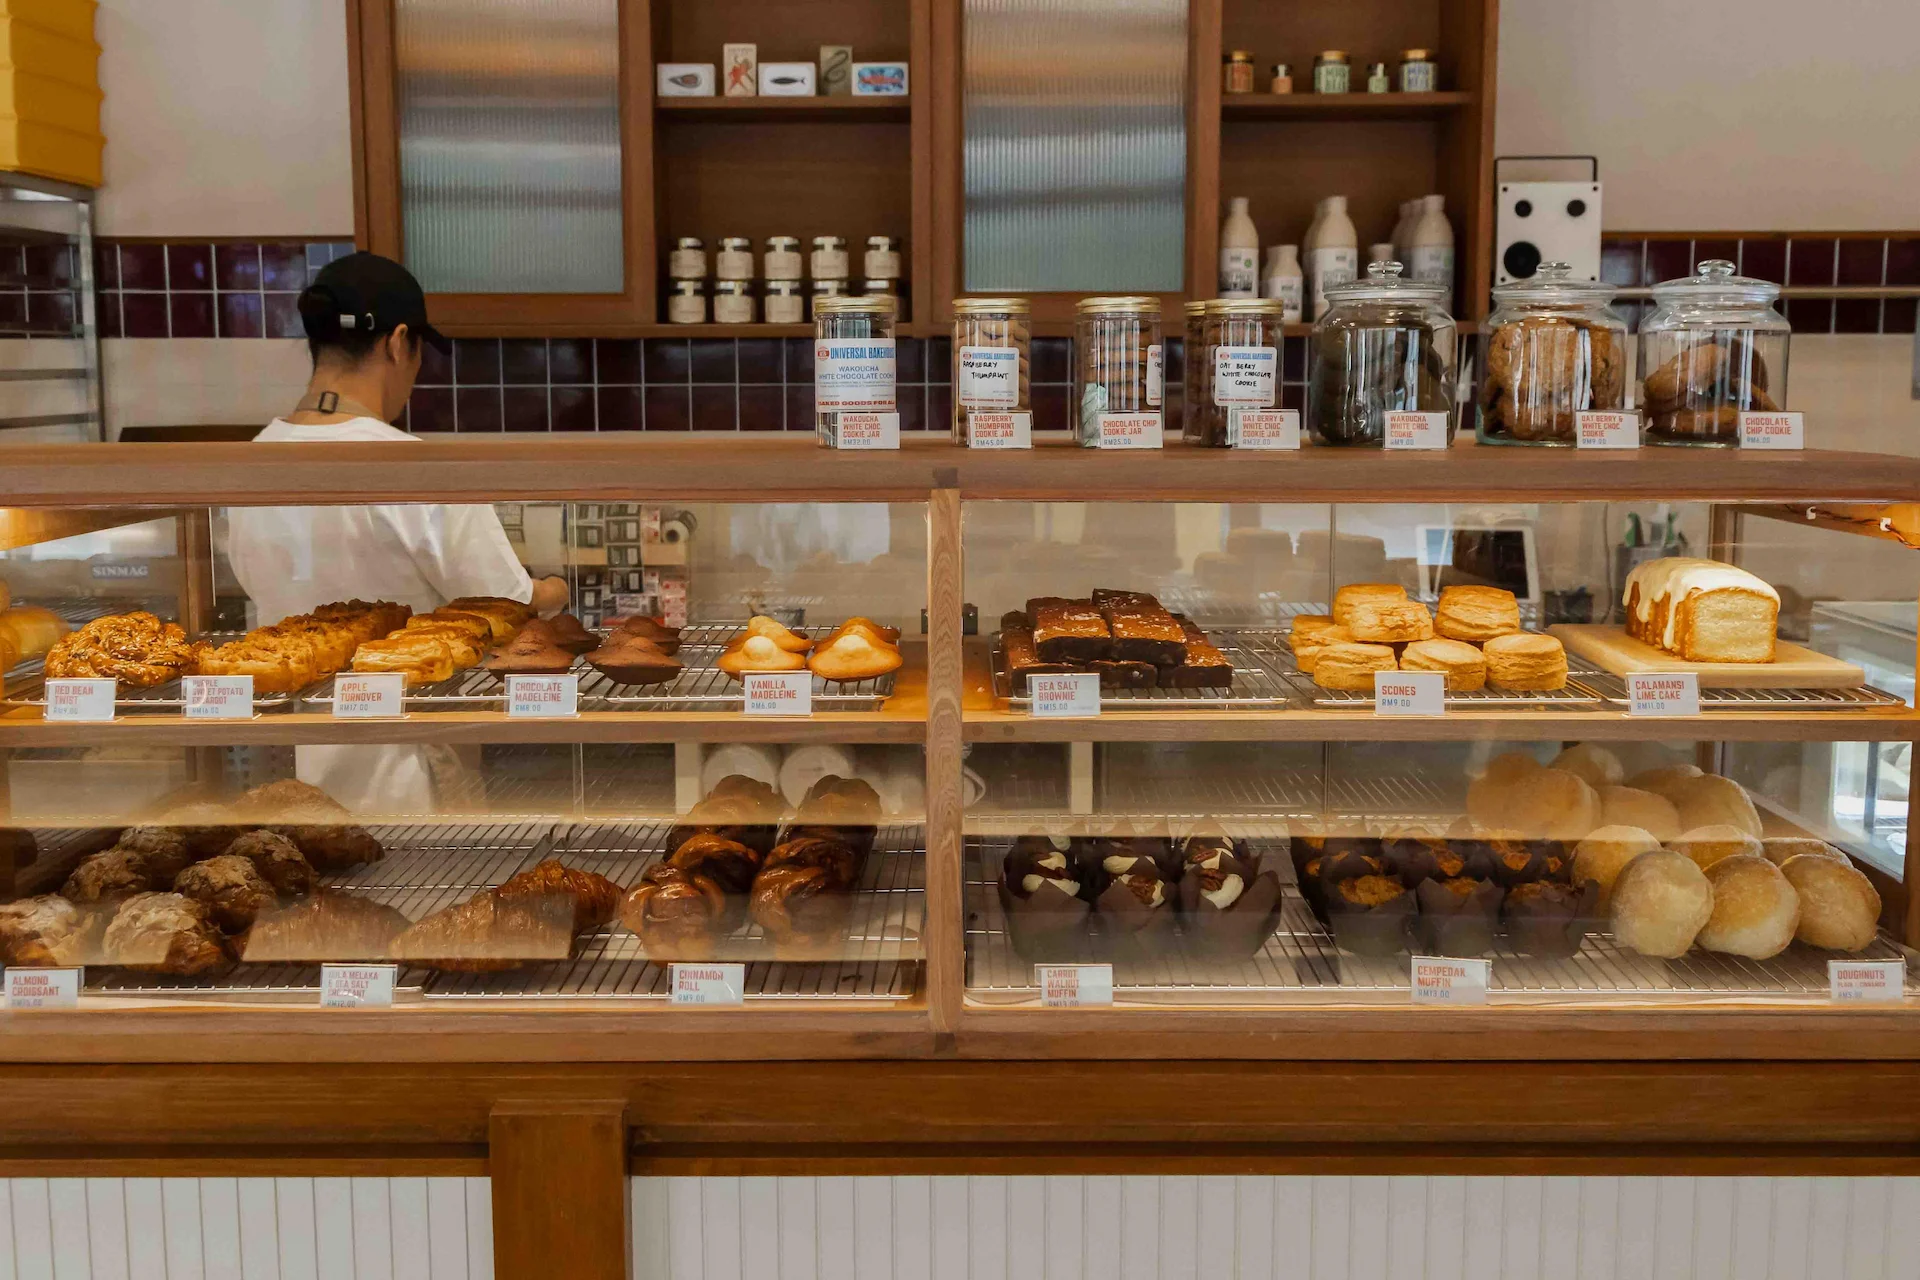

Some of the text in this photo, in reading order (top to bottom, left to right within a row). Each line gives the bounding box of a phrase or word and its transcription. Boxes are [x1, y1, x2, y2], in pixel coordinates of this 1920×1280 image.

[830, 347, 868, 360] UNIVERSAL
[838, 365, 880, 373] WAKOUCHA
[843, 415, 879, 423] WAKOUCHA
[1103, 419, 1157, 428] CHOCOLATE CHIP
[1390, 415, 1427, 423] WAKOUCHA
[1745, 417, 1790, 426] CHOCOLATE
[843, 430, 880, 438] COOKIE JAR
[975, 430, 1014, 438] COOKIE JAR
[1103, 427, 1142, 436] COOKIE JAR
[1390, 430, 1413, 438] COOKIE
[1746, 426, 1792, 435] CHIP COOKIE
[1103, 438, 1132, 446] RM25.00
[92, 565, 149, 577] SINMAG
[55, 685, 94, 695] RED BEAN
[341, 683, 368, 692] APPLE
[515, 682, 563, 692] CHOCOLATE
[751, 680, 786, 690] VANILLA
[1038, 681, 1079, 691] SEA SALT
[1635, 680, 1685, 690] CALAMANSI
[192, 687, 244, 696] SWET POTATO
[750, 690, 797, 700] MADELEINE
[1381, 685, 1416, 696] SCONES
[1636, 690, 1681, 700] LIME CAKE
[55, 695, 78, 705] TWIST
[340, 692, 383, 702] TURNOVER
[515, 692, 561, 702] MADELEINE
[1038, 691, 1075, 701] BROWNIE
[1038, 703, 1068, 711] RM15.00
[1381, 699, 1411, 707] RM9.00
[1637, 702, 1665, 710] RM11.00
[349, 971, 379, 980] MELAKA
[678, 970, 724, 981] CINNAMON
[1047, 969, 1078, 979] CARROT
[1417, 965, 1466, 977] CEMPEDAK
[1837, 969, 1885, 980] DOUGHNUTS
[12, 975, 49, 986] ALMOND
[350, 980, 369, 988] SALT
[1047, 979, 1080, 989] WALNUT
[1417, 977, 1451, 988] MUFFIN
[678, 981, 700, 991] ROLL
[12, 986, 60, 997] CROISSANT
[1047, 989, 1077, 998] MUFFIN
[1418, 989, 1450, 999] RM13.00
